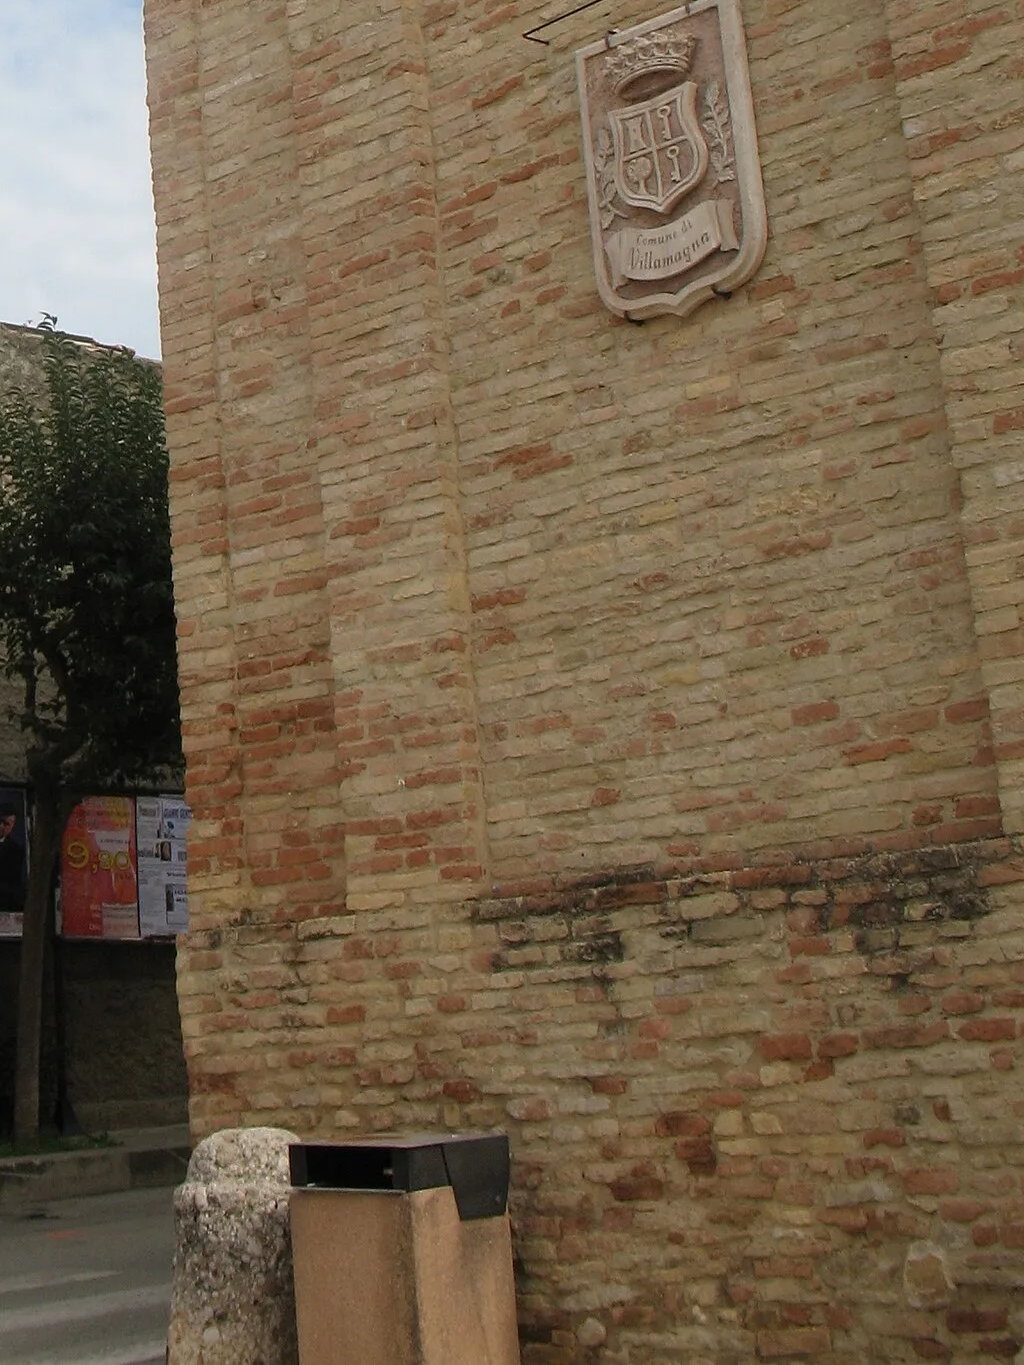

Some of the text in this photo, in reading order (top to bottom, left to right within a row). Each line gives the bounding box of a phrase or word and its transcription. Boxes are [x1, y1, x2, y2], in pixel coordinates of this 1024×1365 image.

[636, 219, 693, 246] Comune di
[630, 232, 710, 270] Villamagna
